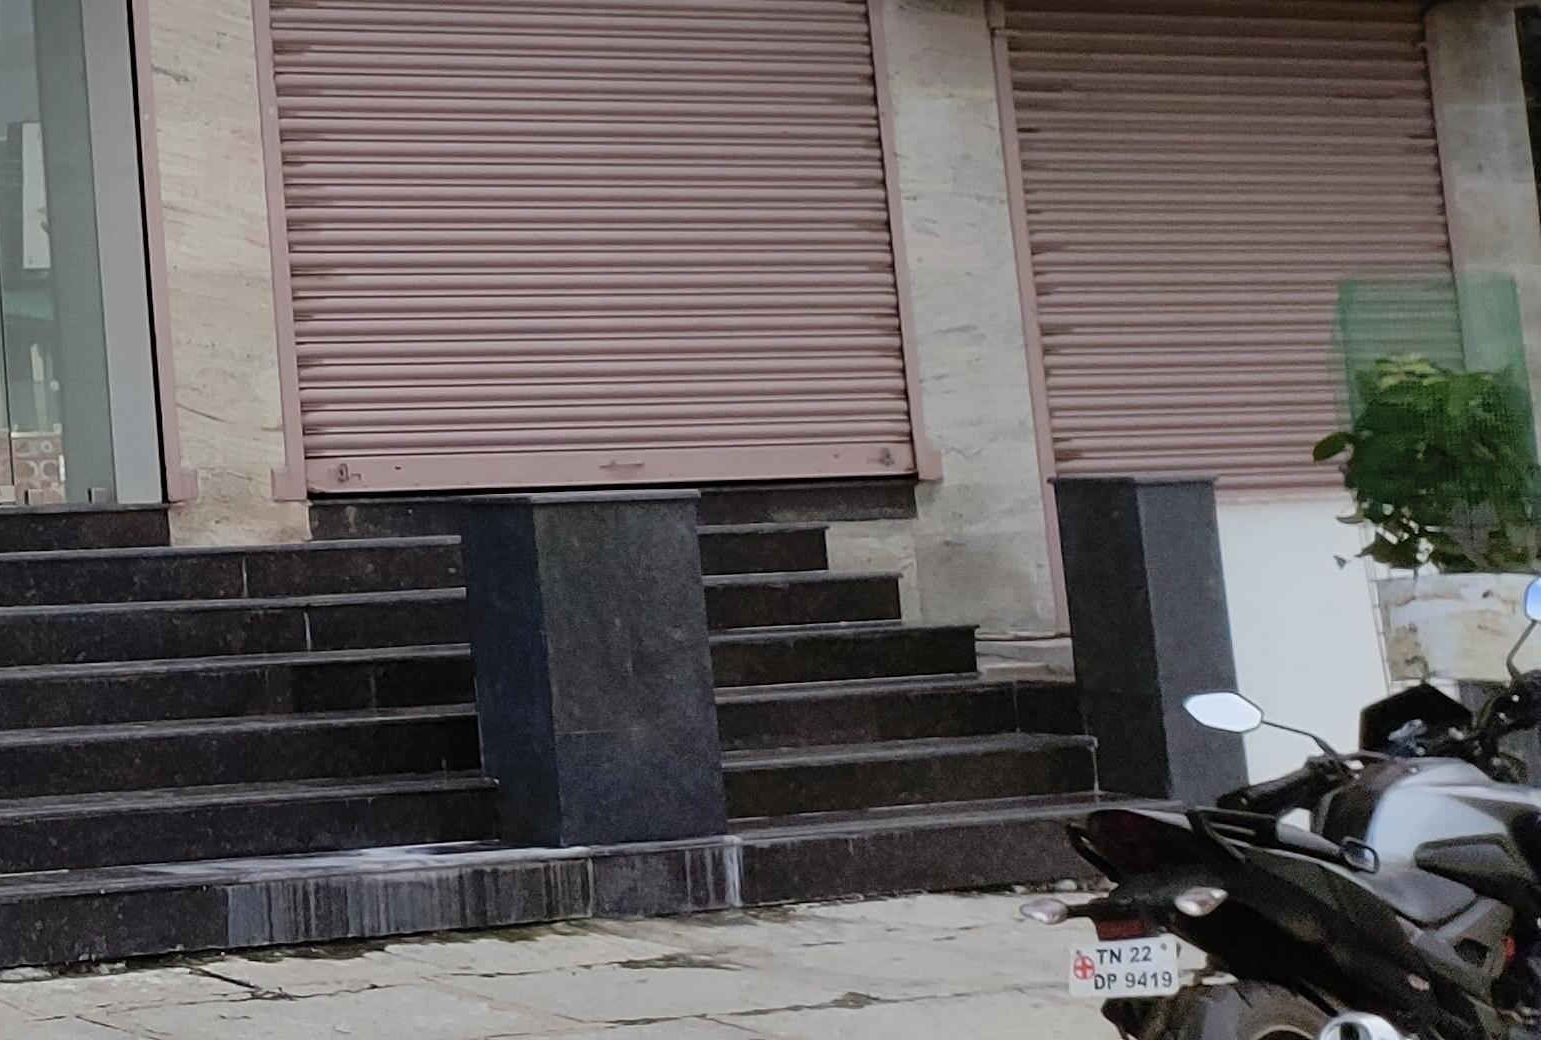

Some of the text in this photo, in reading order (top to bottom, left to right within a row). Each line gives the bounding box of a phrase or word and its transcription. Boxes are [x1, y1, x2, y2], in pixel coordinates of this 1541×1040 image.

[1096, 946, 1152, 964] TN 22
[1094, 971, 1173, 990] DP 9419
